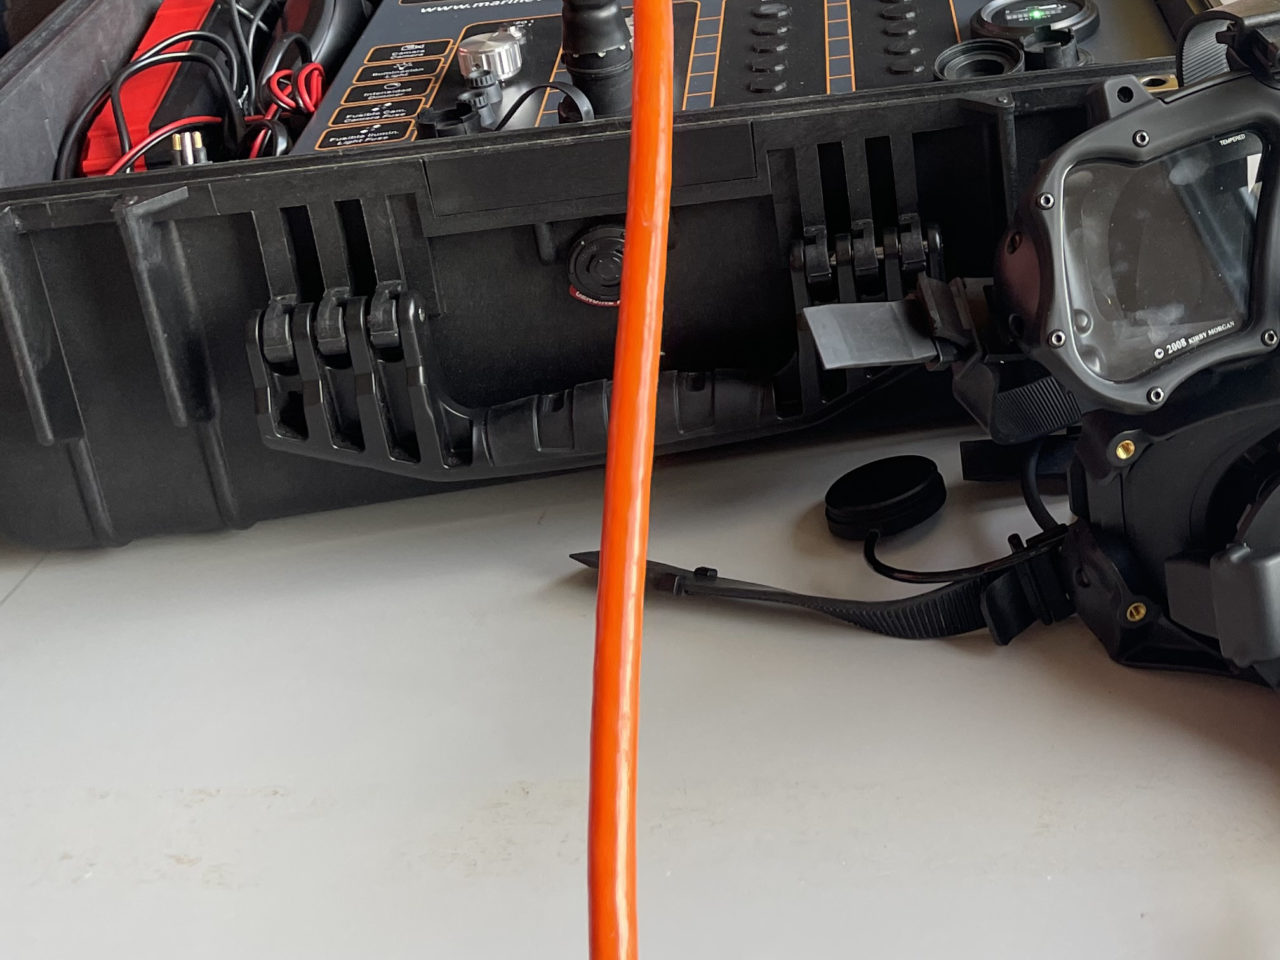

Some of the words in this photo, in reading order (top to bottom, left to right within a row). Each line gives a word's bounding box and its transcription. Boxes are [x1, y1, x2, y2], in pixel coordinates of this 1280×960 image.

[1166, 337, 1188, 355] 2008
[1188, 331, 1207, 345] KIRBY
[1207, 320, 1235, 337] MORGAN
